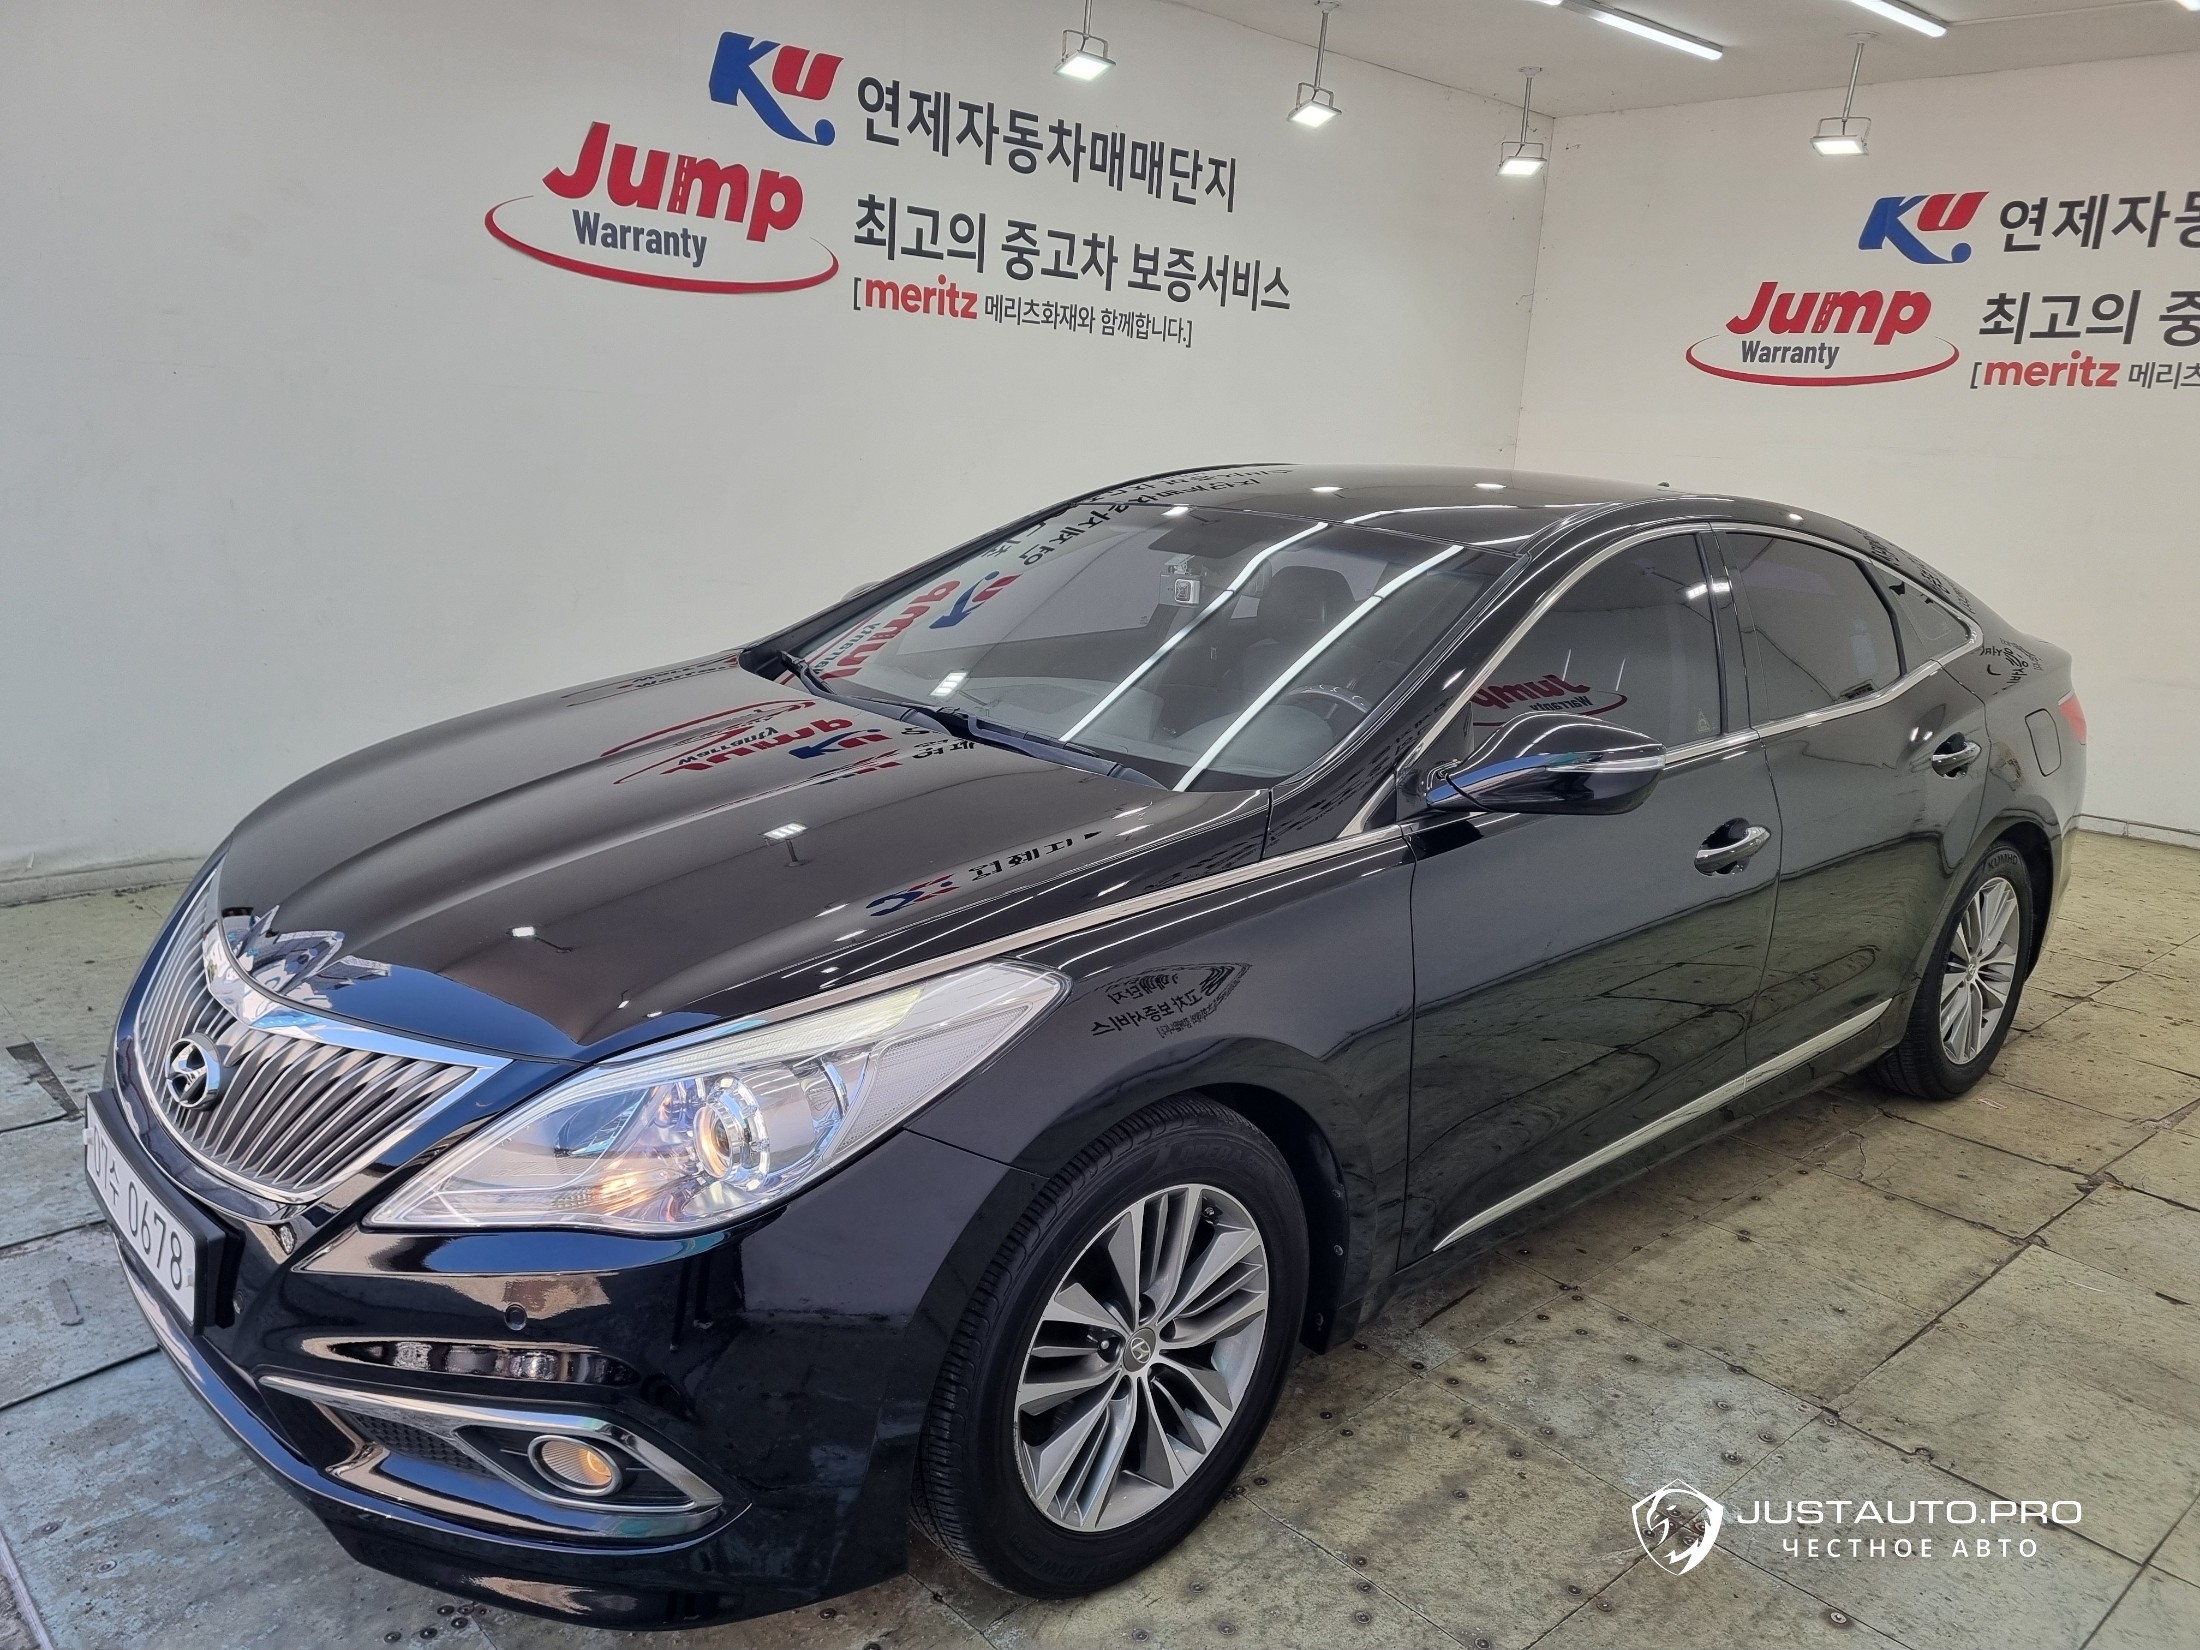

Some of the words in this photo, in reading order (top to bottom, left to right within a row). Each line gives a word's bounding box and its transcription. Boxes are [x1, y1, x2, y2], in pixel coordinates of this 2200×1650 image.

[857, 76, 1236, 212] 연제자동차매매단지
[543, 121, 804, 243] Jump
[572, 209, 708, 268] Warranty
[854, 193, 986, 273] 최고의
[1001, 219, 1119, 292] 중고차
[1127, 243, 1291, 312] 보증서비스
[984, 294, 1096, 335] 메리츠화재와
[1726, 281, 1933, 346] Jump
[1978, 289, 2142, 345] 최고의
[1741, 340, 1840, 370] Warranty
[127, 1180, 183, 1291] 0678
